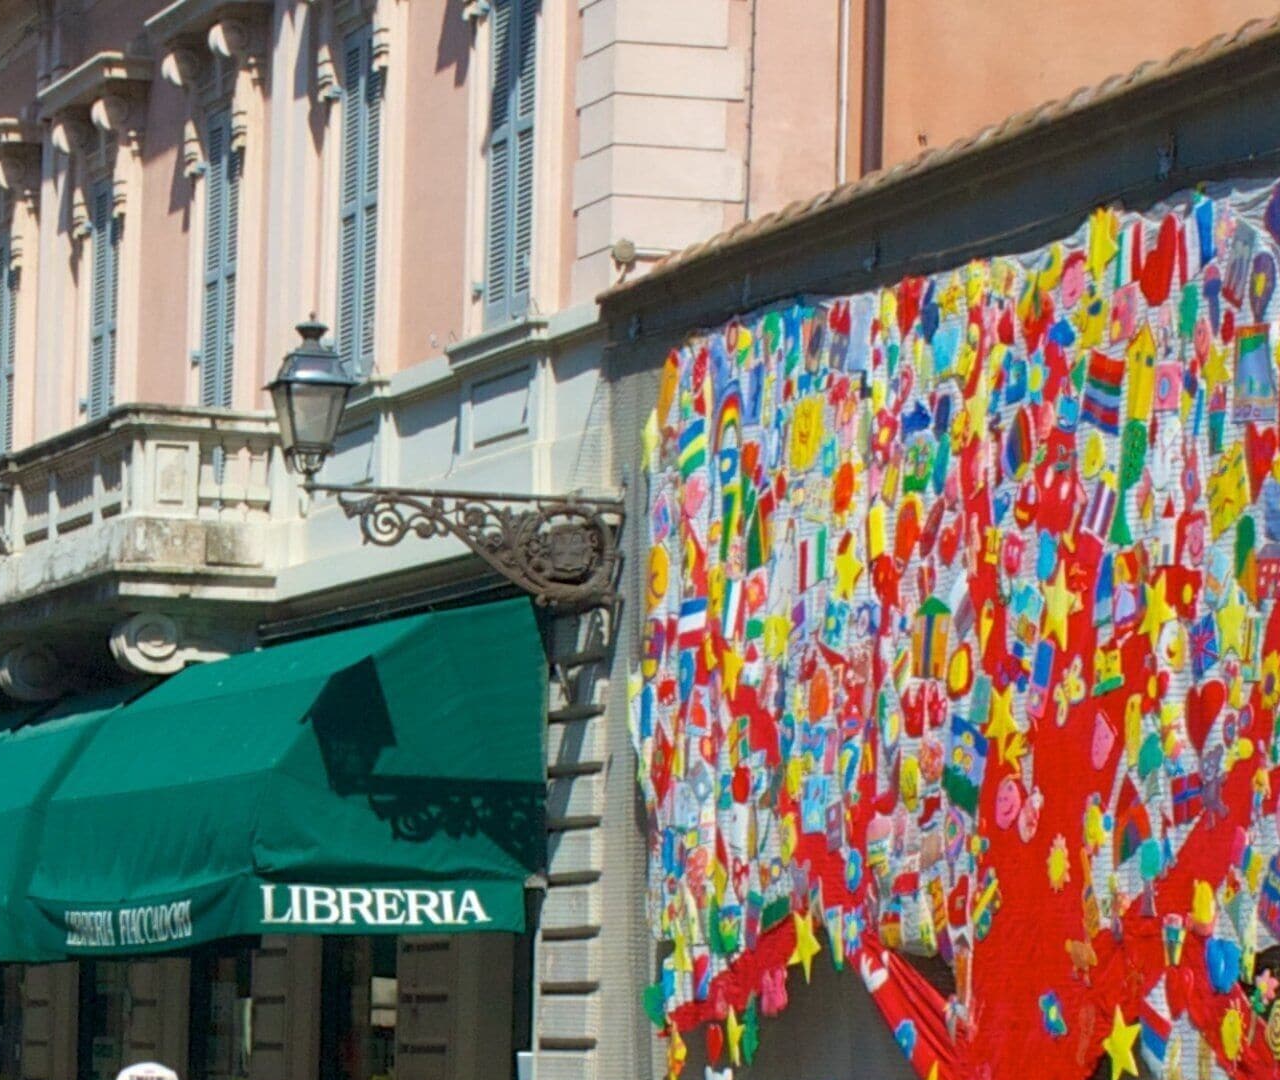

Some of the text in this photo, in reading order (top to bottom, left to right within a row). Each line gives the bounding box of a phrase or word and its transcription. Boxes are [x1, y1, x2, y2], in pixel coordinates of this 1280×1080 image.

[65, 898, 194, 947] LIBRERIA FIACCADORI
[260, 884, 493, 926] LIBRERIA
